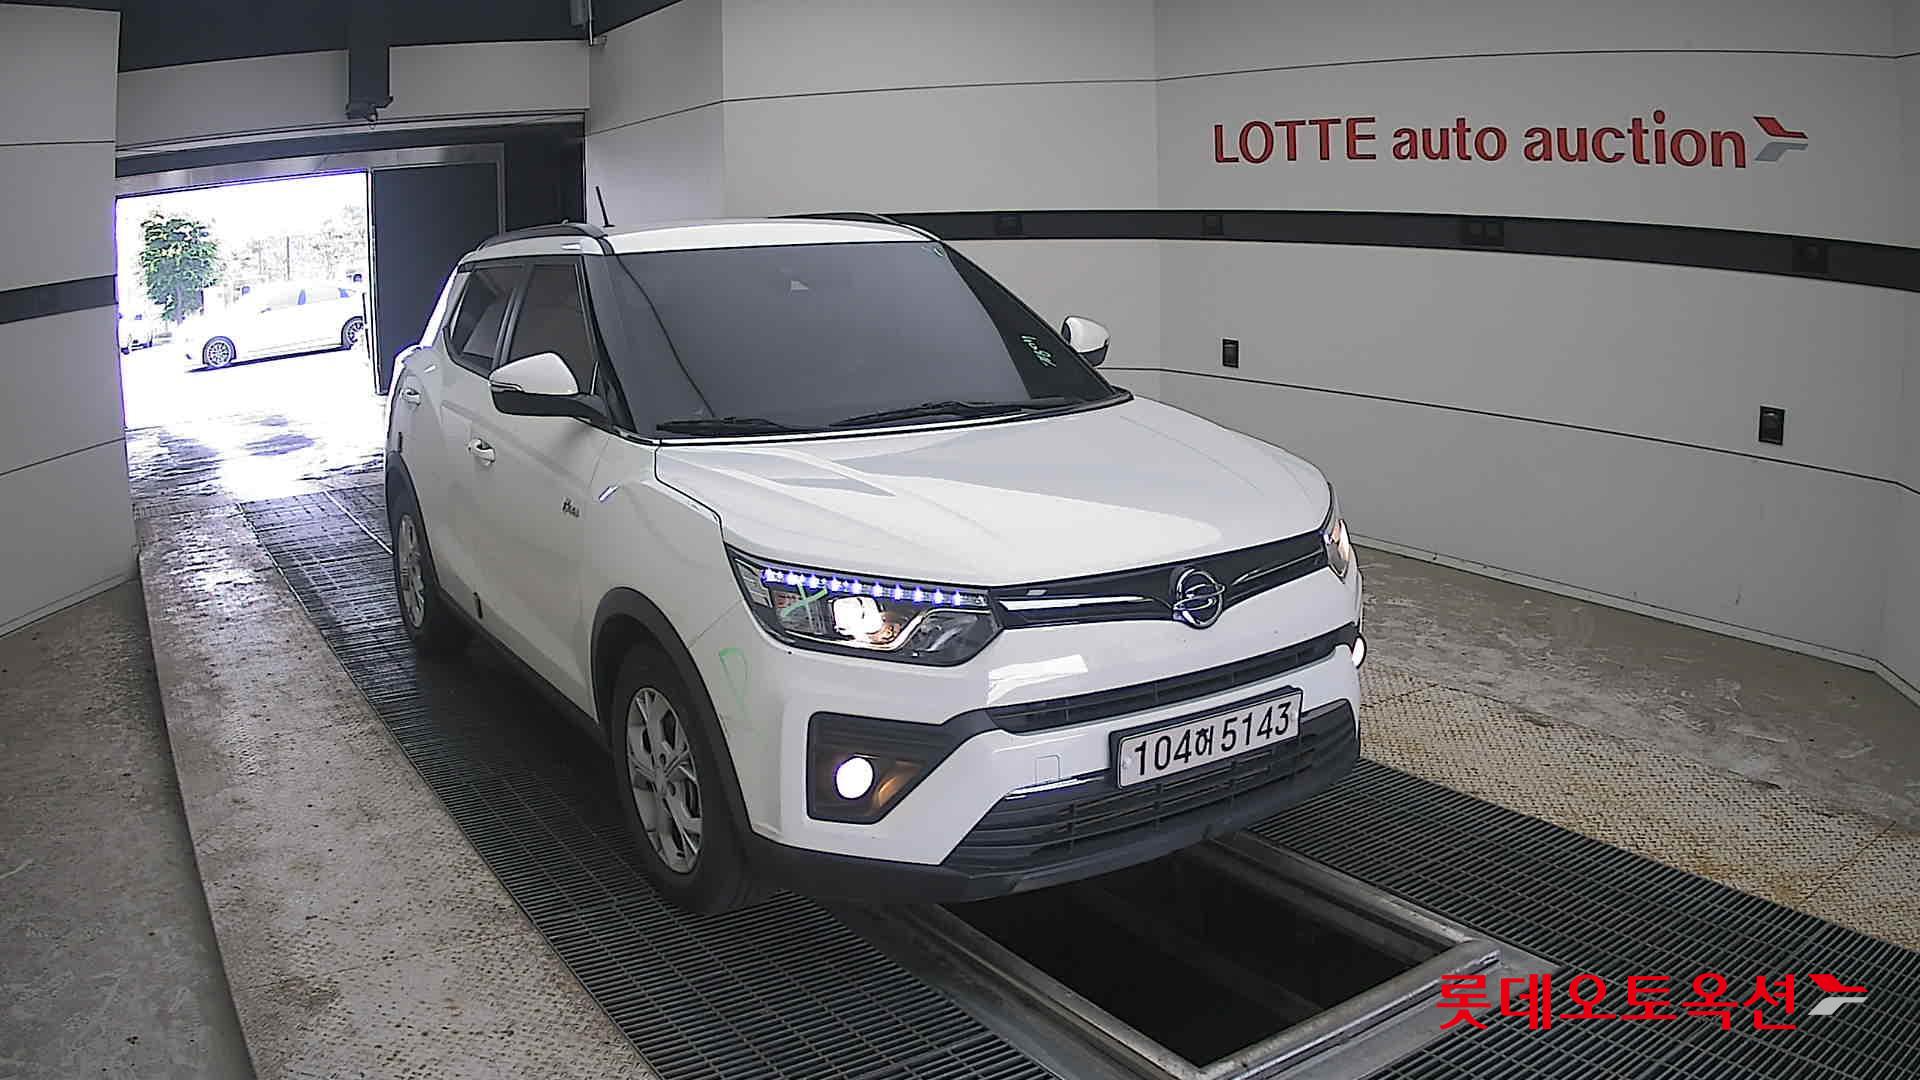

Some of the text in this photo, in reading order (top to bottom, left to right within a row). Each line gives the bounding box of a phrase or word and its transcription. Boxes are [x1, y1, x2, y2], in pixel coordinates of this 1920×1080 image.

[1213, 110, 1747, 168] LOTTE auto auction
